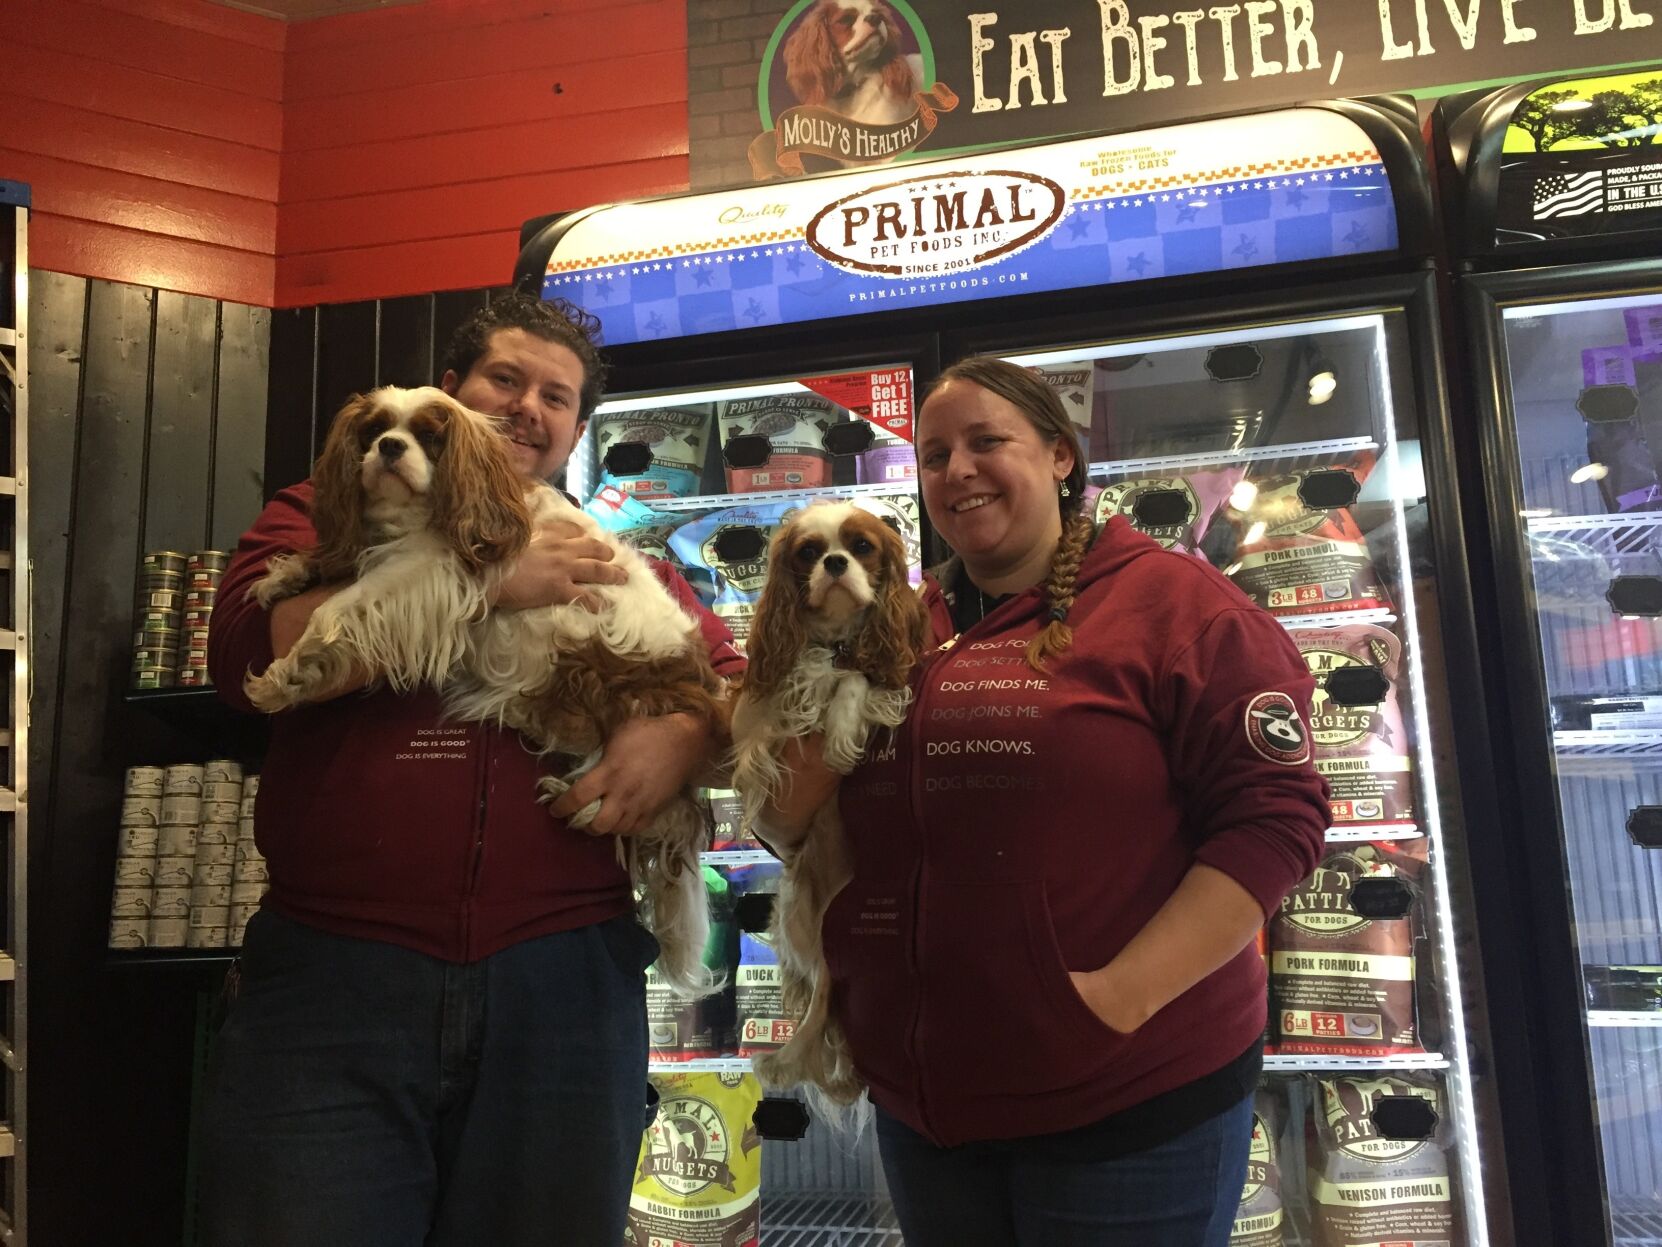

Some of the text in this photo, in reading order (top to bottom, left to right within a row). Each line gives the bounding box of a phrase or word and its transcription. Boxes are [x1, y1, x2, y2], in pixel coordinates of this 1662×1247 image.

[967, 12, 1071, 113] EAT
[1097, 0, 1344, 96] BETTER,
[784, 114, 920, 157] MOLLY'S HEALTHY
[1091, 158, 1169, 177] DOGS CATS
[1606, 165, 1640, 175] PROUDLY
[1607, 175, 1631, 185] MADE,
[1631, 174, 1638, 182] &
[1607, 188, 1620, 201] IN
[1623, 185, 1646, 199] THE
[718, 203, 791, 224] Quality
[1607, 204, 1623, 212] GOD
[1623, 201, 1644, 210] BLESS
[841, 184, 1036, 247] PRIMAL
[870, 243, 900, 259] PET
[910, 234, 963, 254] FOODS
[905, 258, 971, 274] SINCE 2001
[870, 373, 892, 386] Buy
[1048, 374, 1082, 385] ONTO
[871, 384, 897, 401] Get
[899, 382, 907, 398] 1
[728, 397, 829, 415] PRIMAL PRONTO
[872, 399, 908, 418] FREE
[1264, 543, 1339, 562] PORK FORMULA
[1301, 589, 1318, 599] 48
[969, 642, 1002, 651] DOG
[940, 679, 1050, 692] DOG FINDS ME.
[931, 704, 1043, 721] DOG JOINS ME.
[1310, 715, 1370, 729] GGETS
[876, 748, 896, 761] AM
[926, 740, 1036, 756] DOG KNOWS.
[422, 752, 467, 760] EVERYTHING
[1327, 761, 1370, 771] FORMULA
[925, 777, 962, 792] DOG
[1331, 805, 1348, 814] 48
[1281, 893, 1354, 913] PATTI
[1304, 916, 1348, 925] FOR DOGS
[1286, 957, 1370, 973] PORK FORMULA
[746, 969, 774, 981] DUCK
[776, 1025, 794, 1037] 12
[1317, 1018, 1337, 1030] 12
[1361, 1140, 1407, 1152] FOR DOGS
[1337, 1183, 1443, 1202] VENISON FORMULA
[647, 1201, 721, 1220] RABBIT FORMULA
